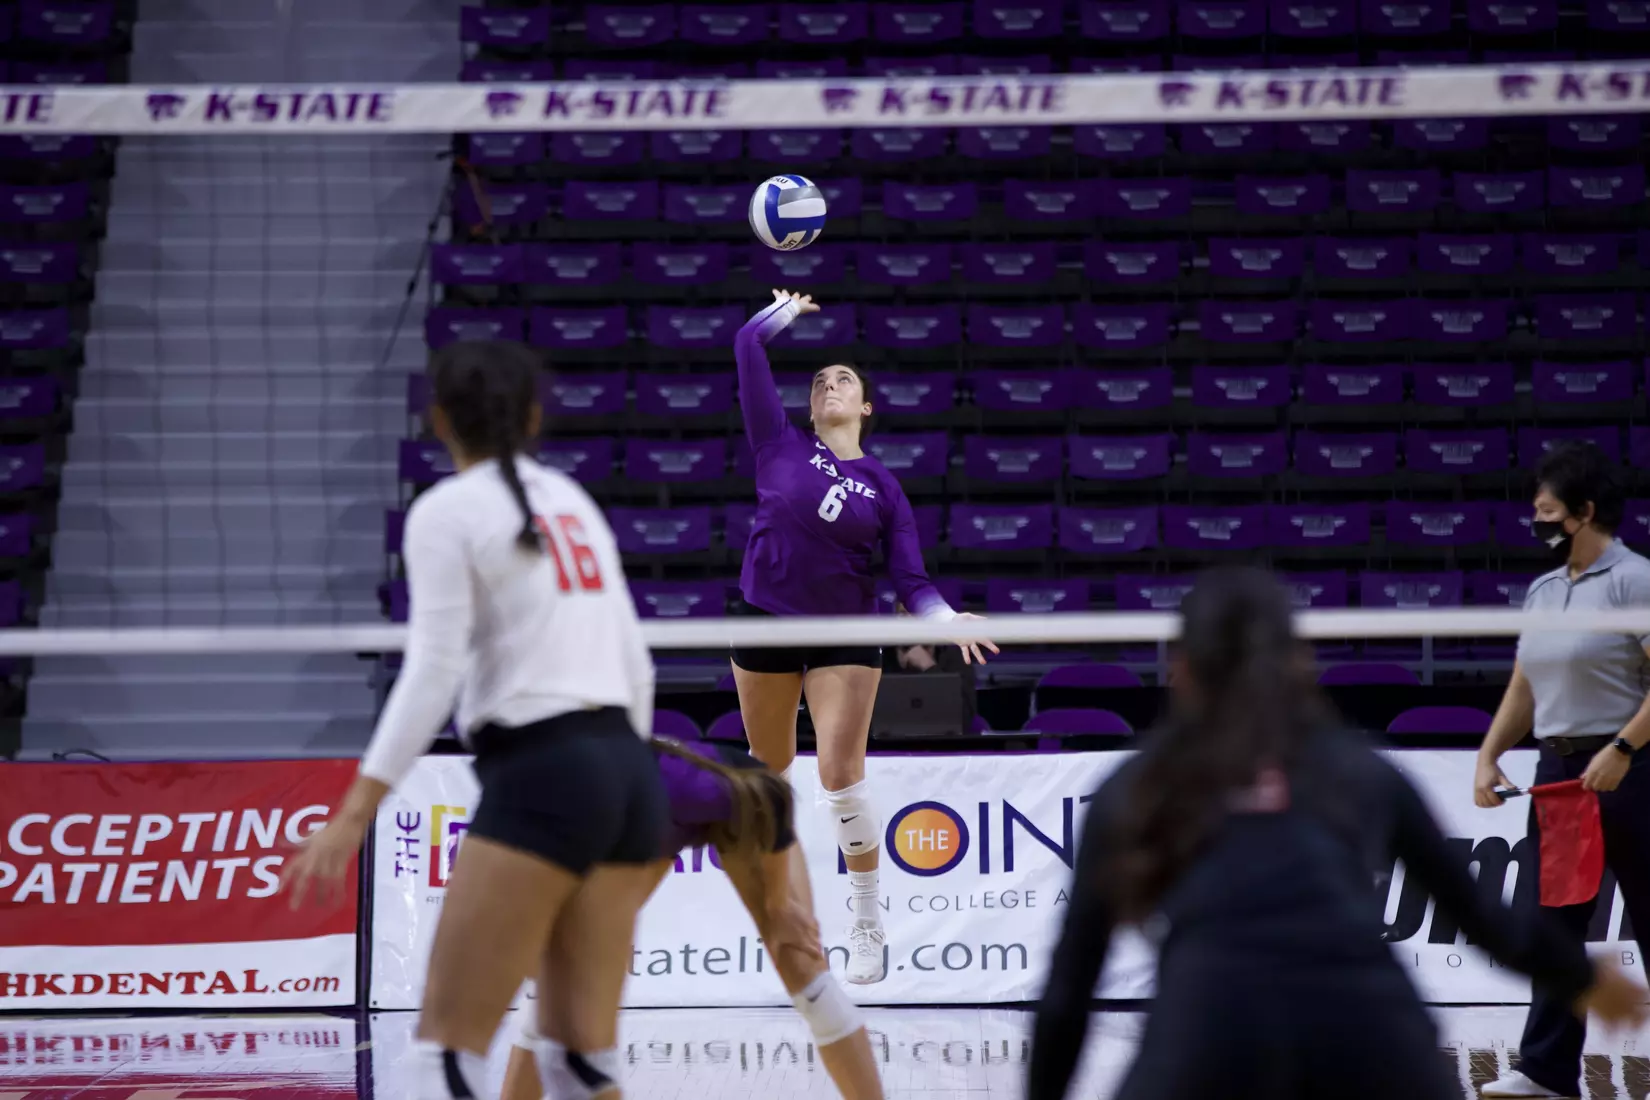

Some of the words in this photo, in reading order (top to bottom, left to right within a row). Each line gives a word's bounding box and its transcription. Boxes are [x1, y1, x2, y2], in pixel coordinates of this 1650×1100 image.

[204, 91, 393, 122] K-STATE
[543, 88, 730, 119] K-STATE
[877, 84, 1066, 115] K-STATE
[1214, 78, 1403, 109] K-STATE
[817, 484, 847, 523] 6
[532, 513, 604, 593] 16
[0, 805, 331, 856] CCEPTING
[837, 797, 1094, 876] OIN
[904, 829, 950, 851] THE
[908, 889, 1037, 912] COLLEGE
